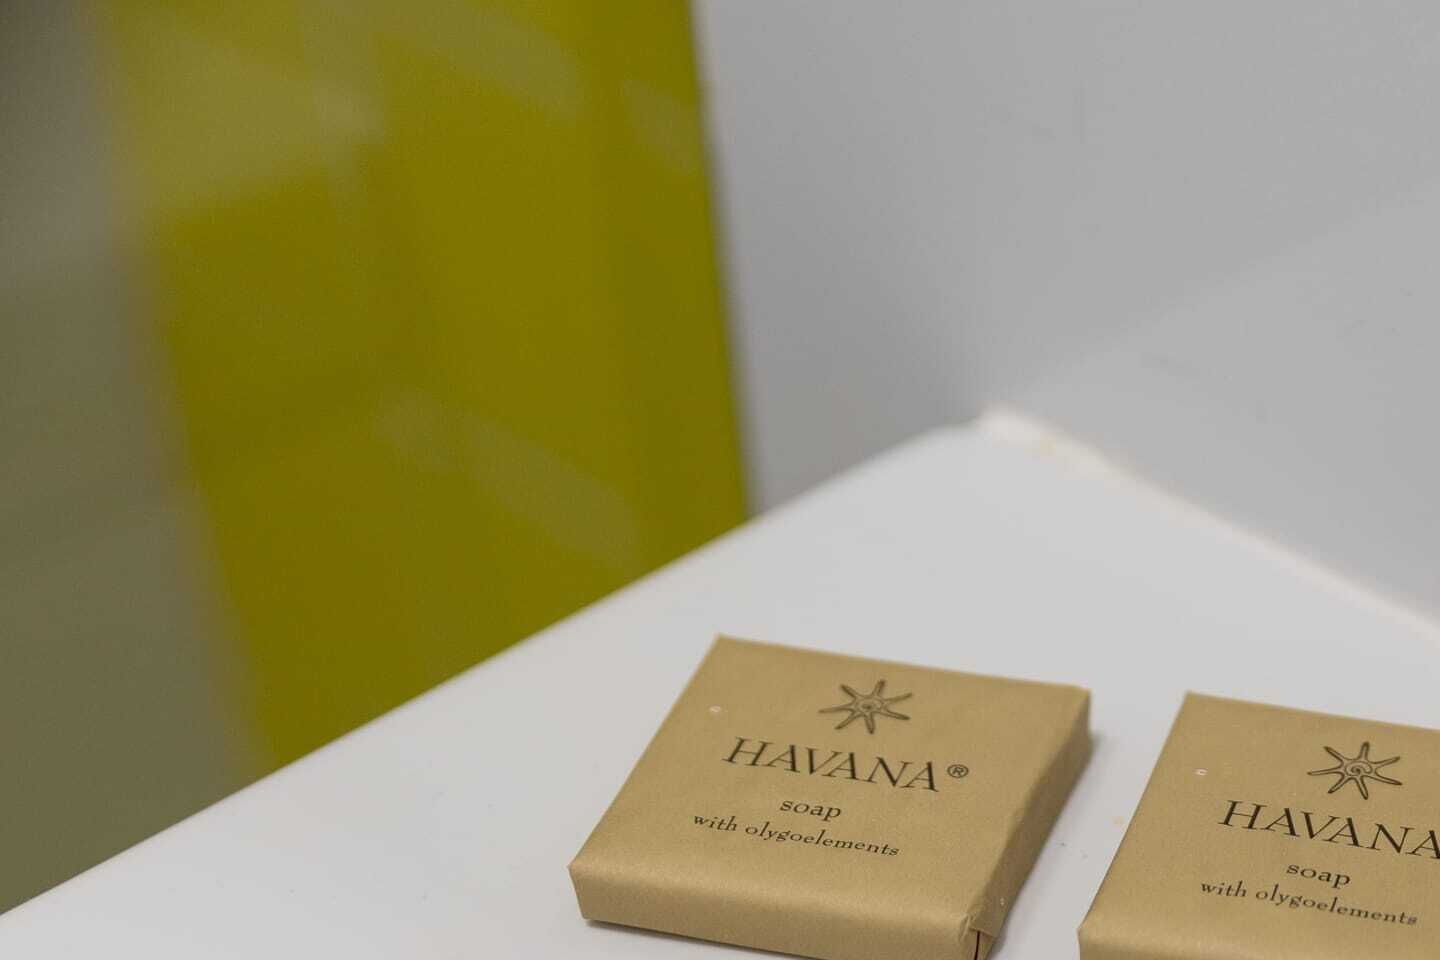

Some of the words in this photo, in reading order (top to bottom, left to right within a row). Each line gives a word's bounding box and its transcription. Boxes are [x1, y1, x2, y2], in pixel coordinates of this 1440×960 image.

[779, 799, 842, 822] soap
[693, 814, 738, 833] with
[744, 820, 900, 857] olygoelements
[1285, 862, 1352, 888] soap
[1200, 880, 1248, 899] with
[1255, 884, 1419, 926] olygoelements
